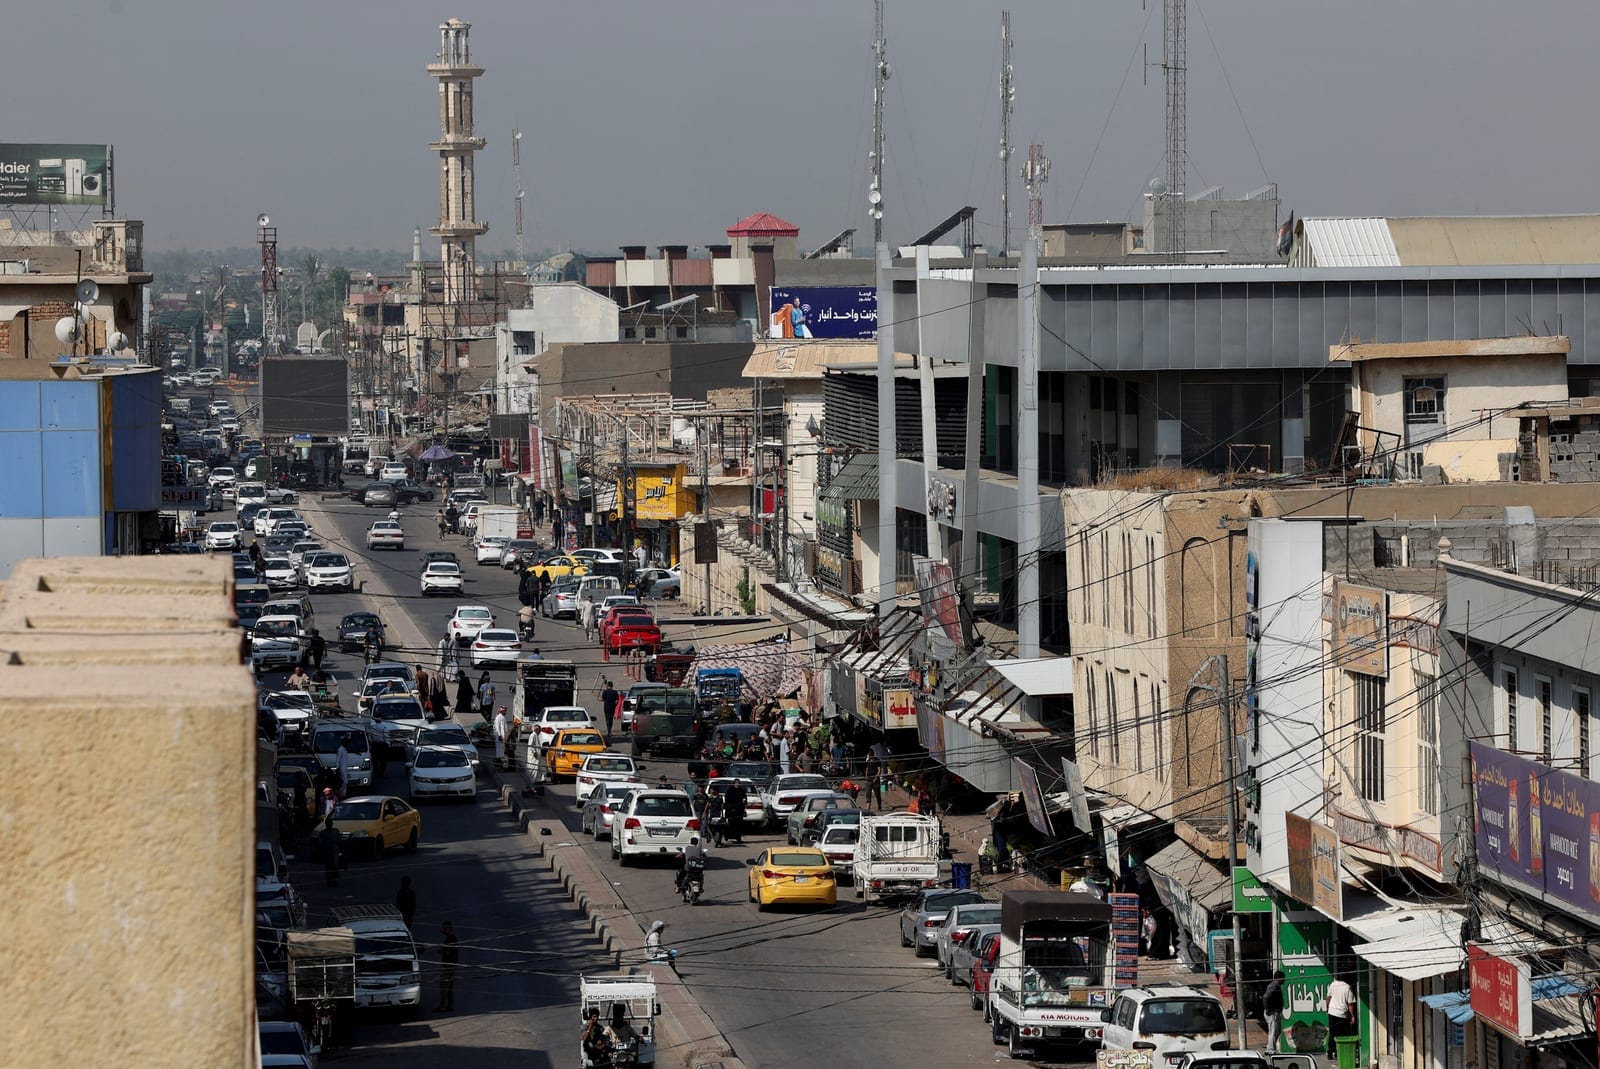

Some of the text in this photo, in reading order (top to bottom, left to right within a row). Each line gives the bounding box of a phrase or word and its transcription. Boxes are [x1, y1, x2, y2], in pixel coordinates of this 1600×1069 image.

[0, 161, 30, 173] Haier
[817, 307, 832, 323] أنبار
[833, 308, 859, 322] واحد
